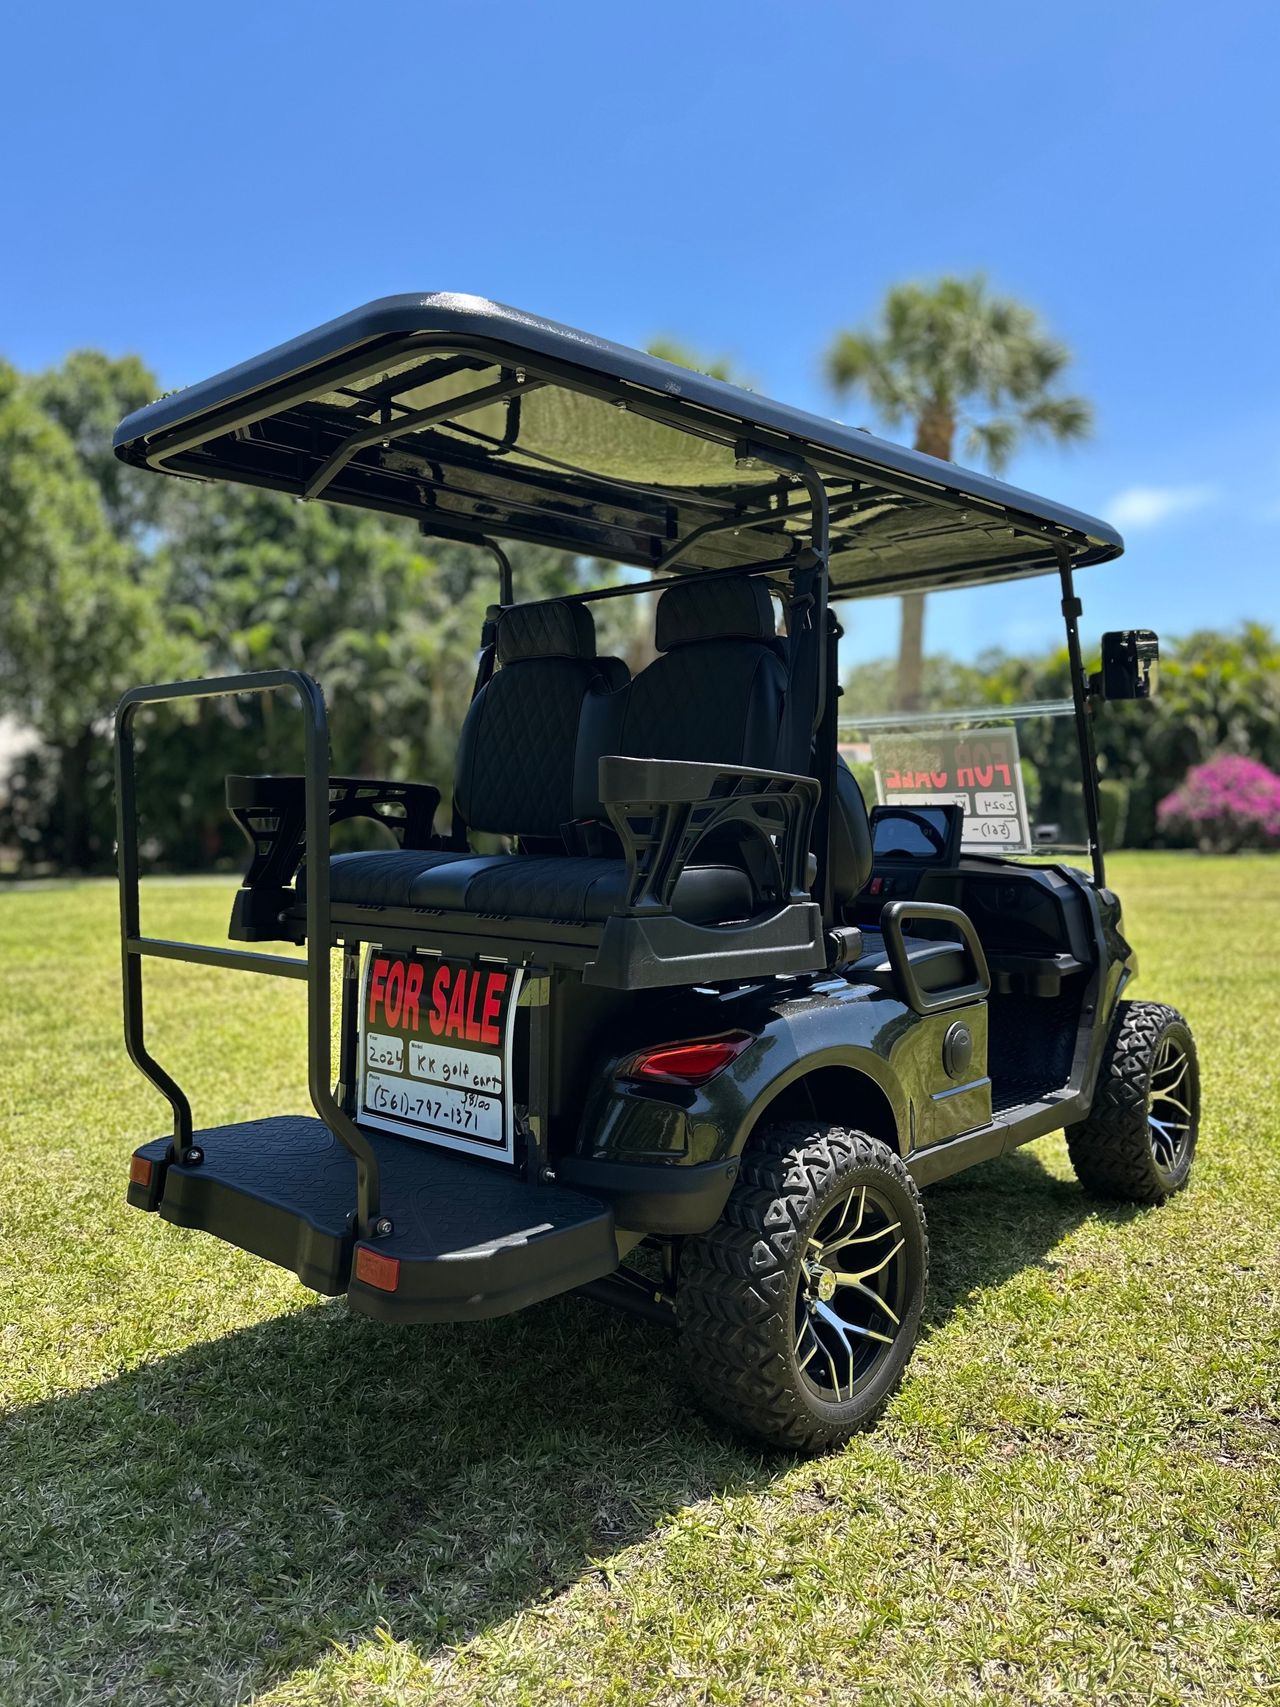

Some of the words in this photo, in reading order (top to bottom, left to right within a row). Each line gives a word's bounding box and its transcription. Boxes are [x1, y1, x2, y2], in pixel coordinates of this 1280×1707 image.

[369, 959, 424, 1031] FOR
[429, 965, 507, 1045] SALE
[369, 1046, 404, 1070] 2024
[443, 1061, 469, 1081] golf
[374, 1084, 478, 1130] (561)-797-1371
